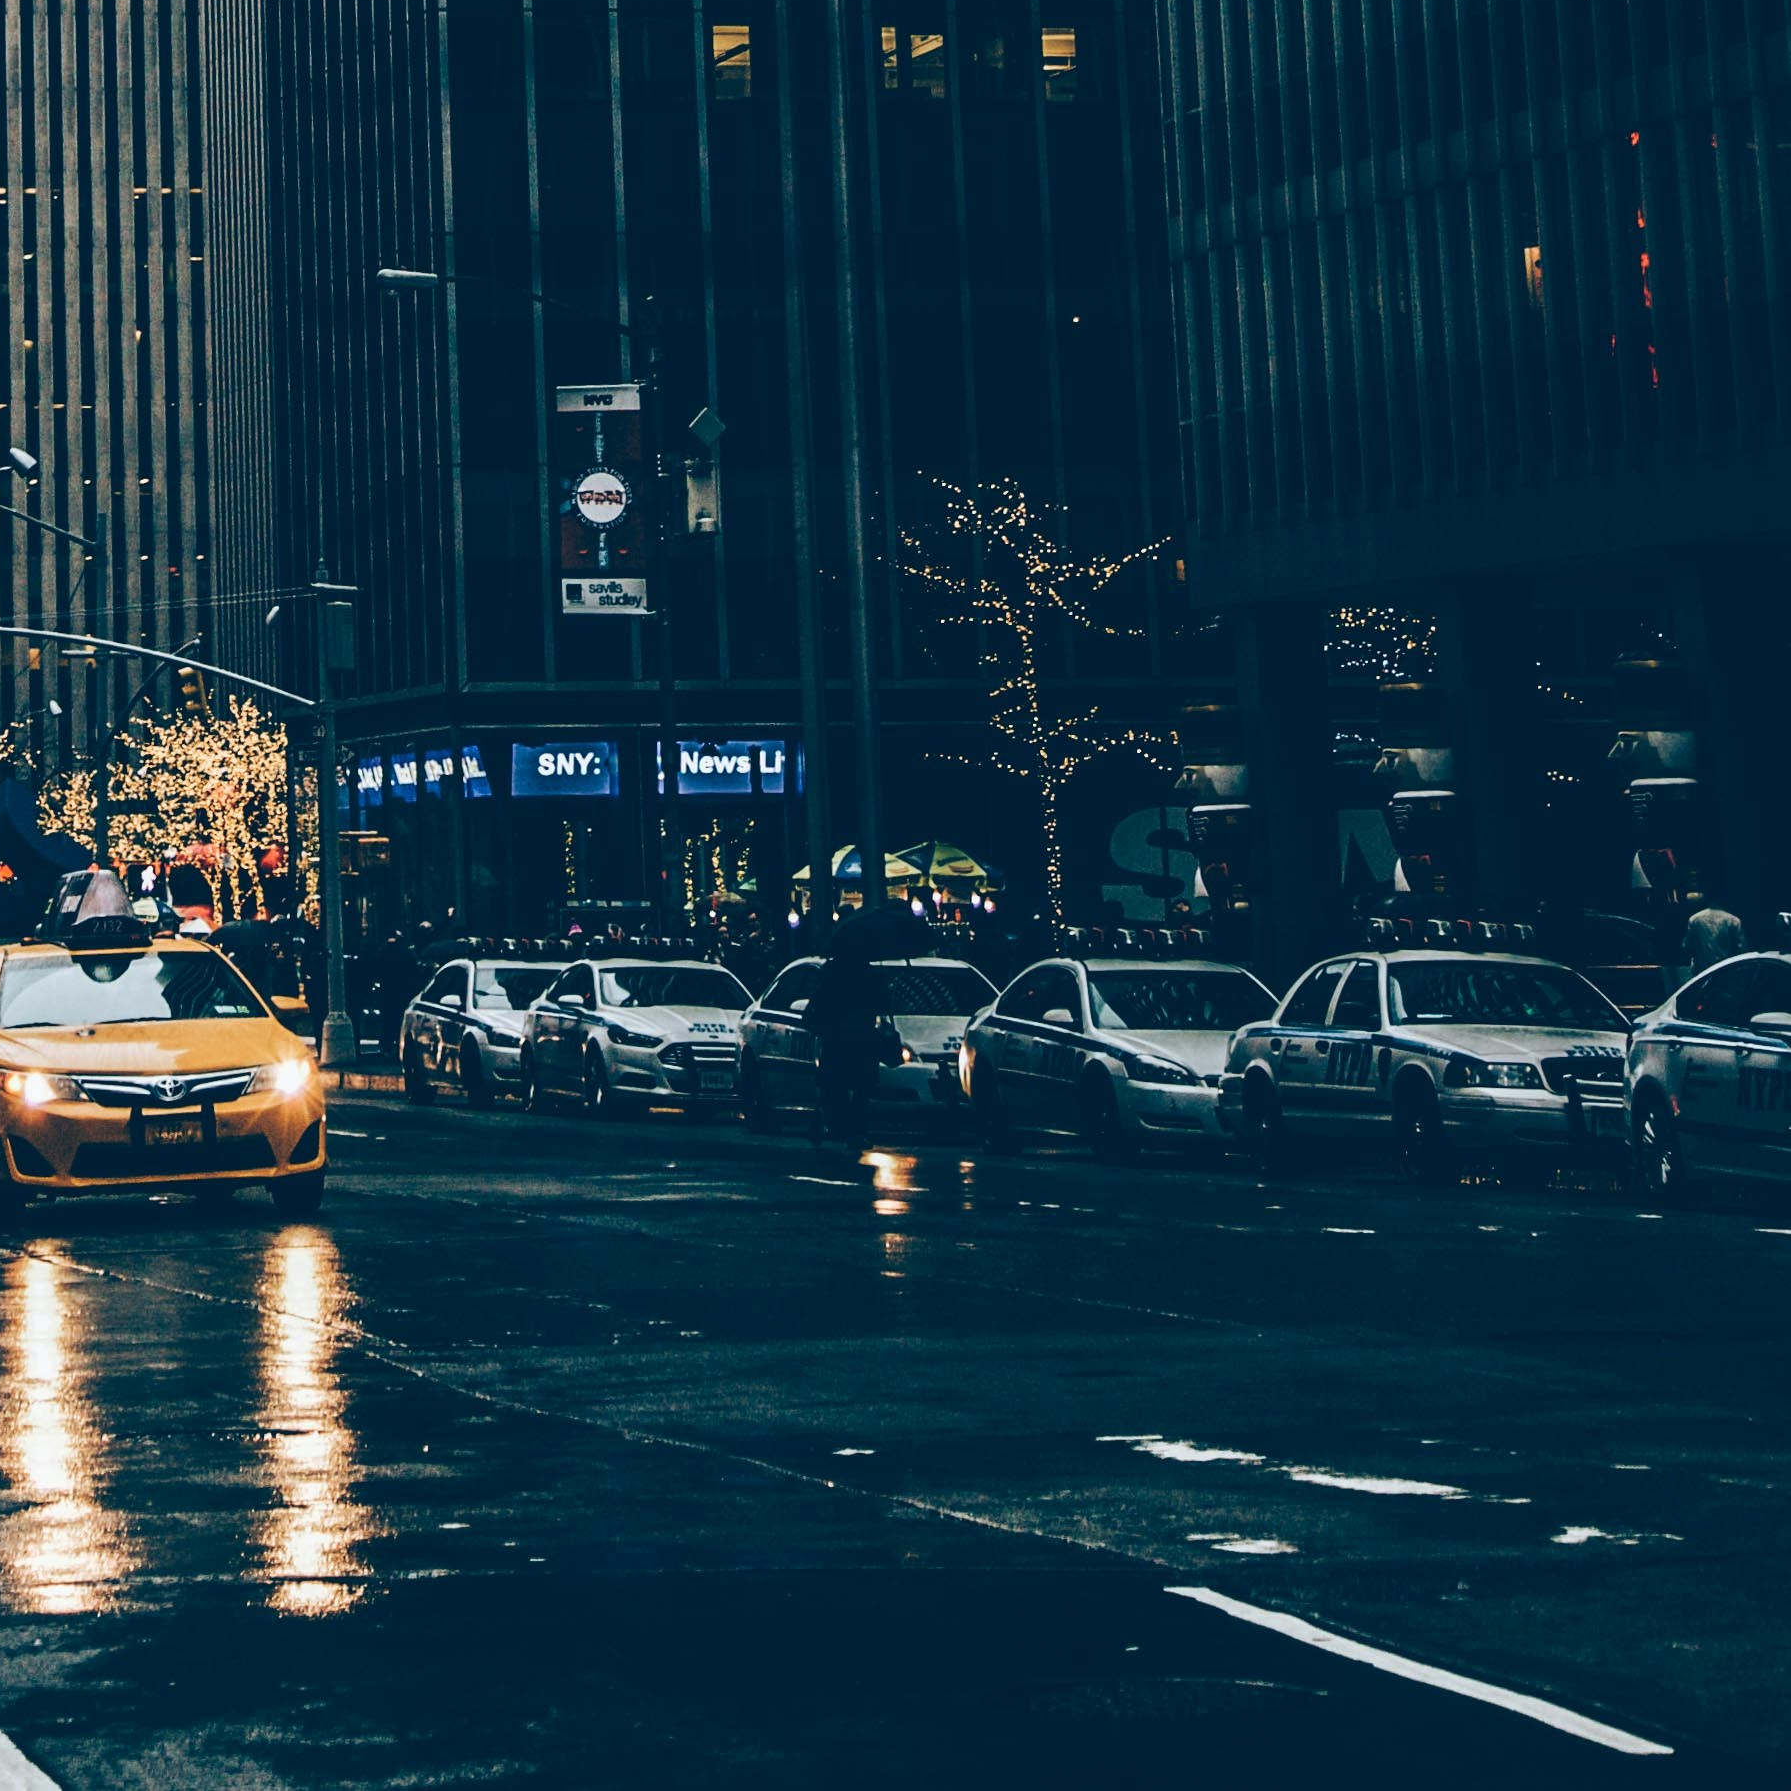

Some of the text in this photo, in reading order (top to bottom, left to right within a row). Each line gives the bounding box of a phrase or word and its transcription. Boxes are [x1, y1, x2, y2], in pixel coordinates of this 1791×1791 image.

[583, 394, 613, 406] NYC
[589, 581, 623, 594] savills
[598, 593, 643, 608] studley
[537, 752, 601, 776] SNY:
[680, 750, 751, 774] News
